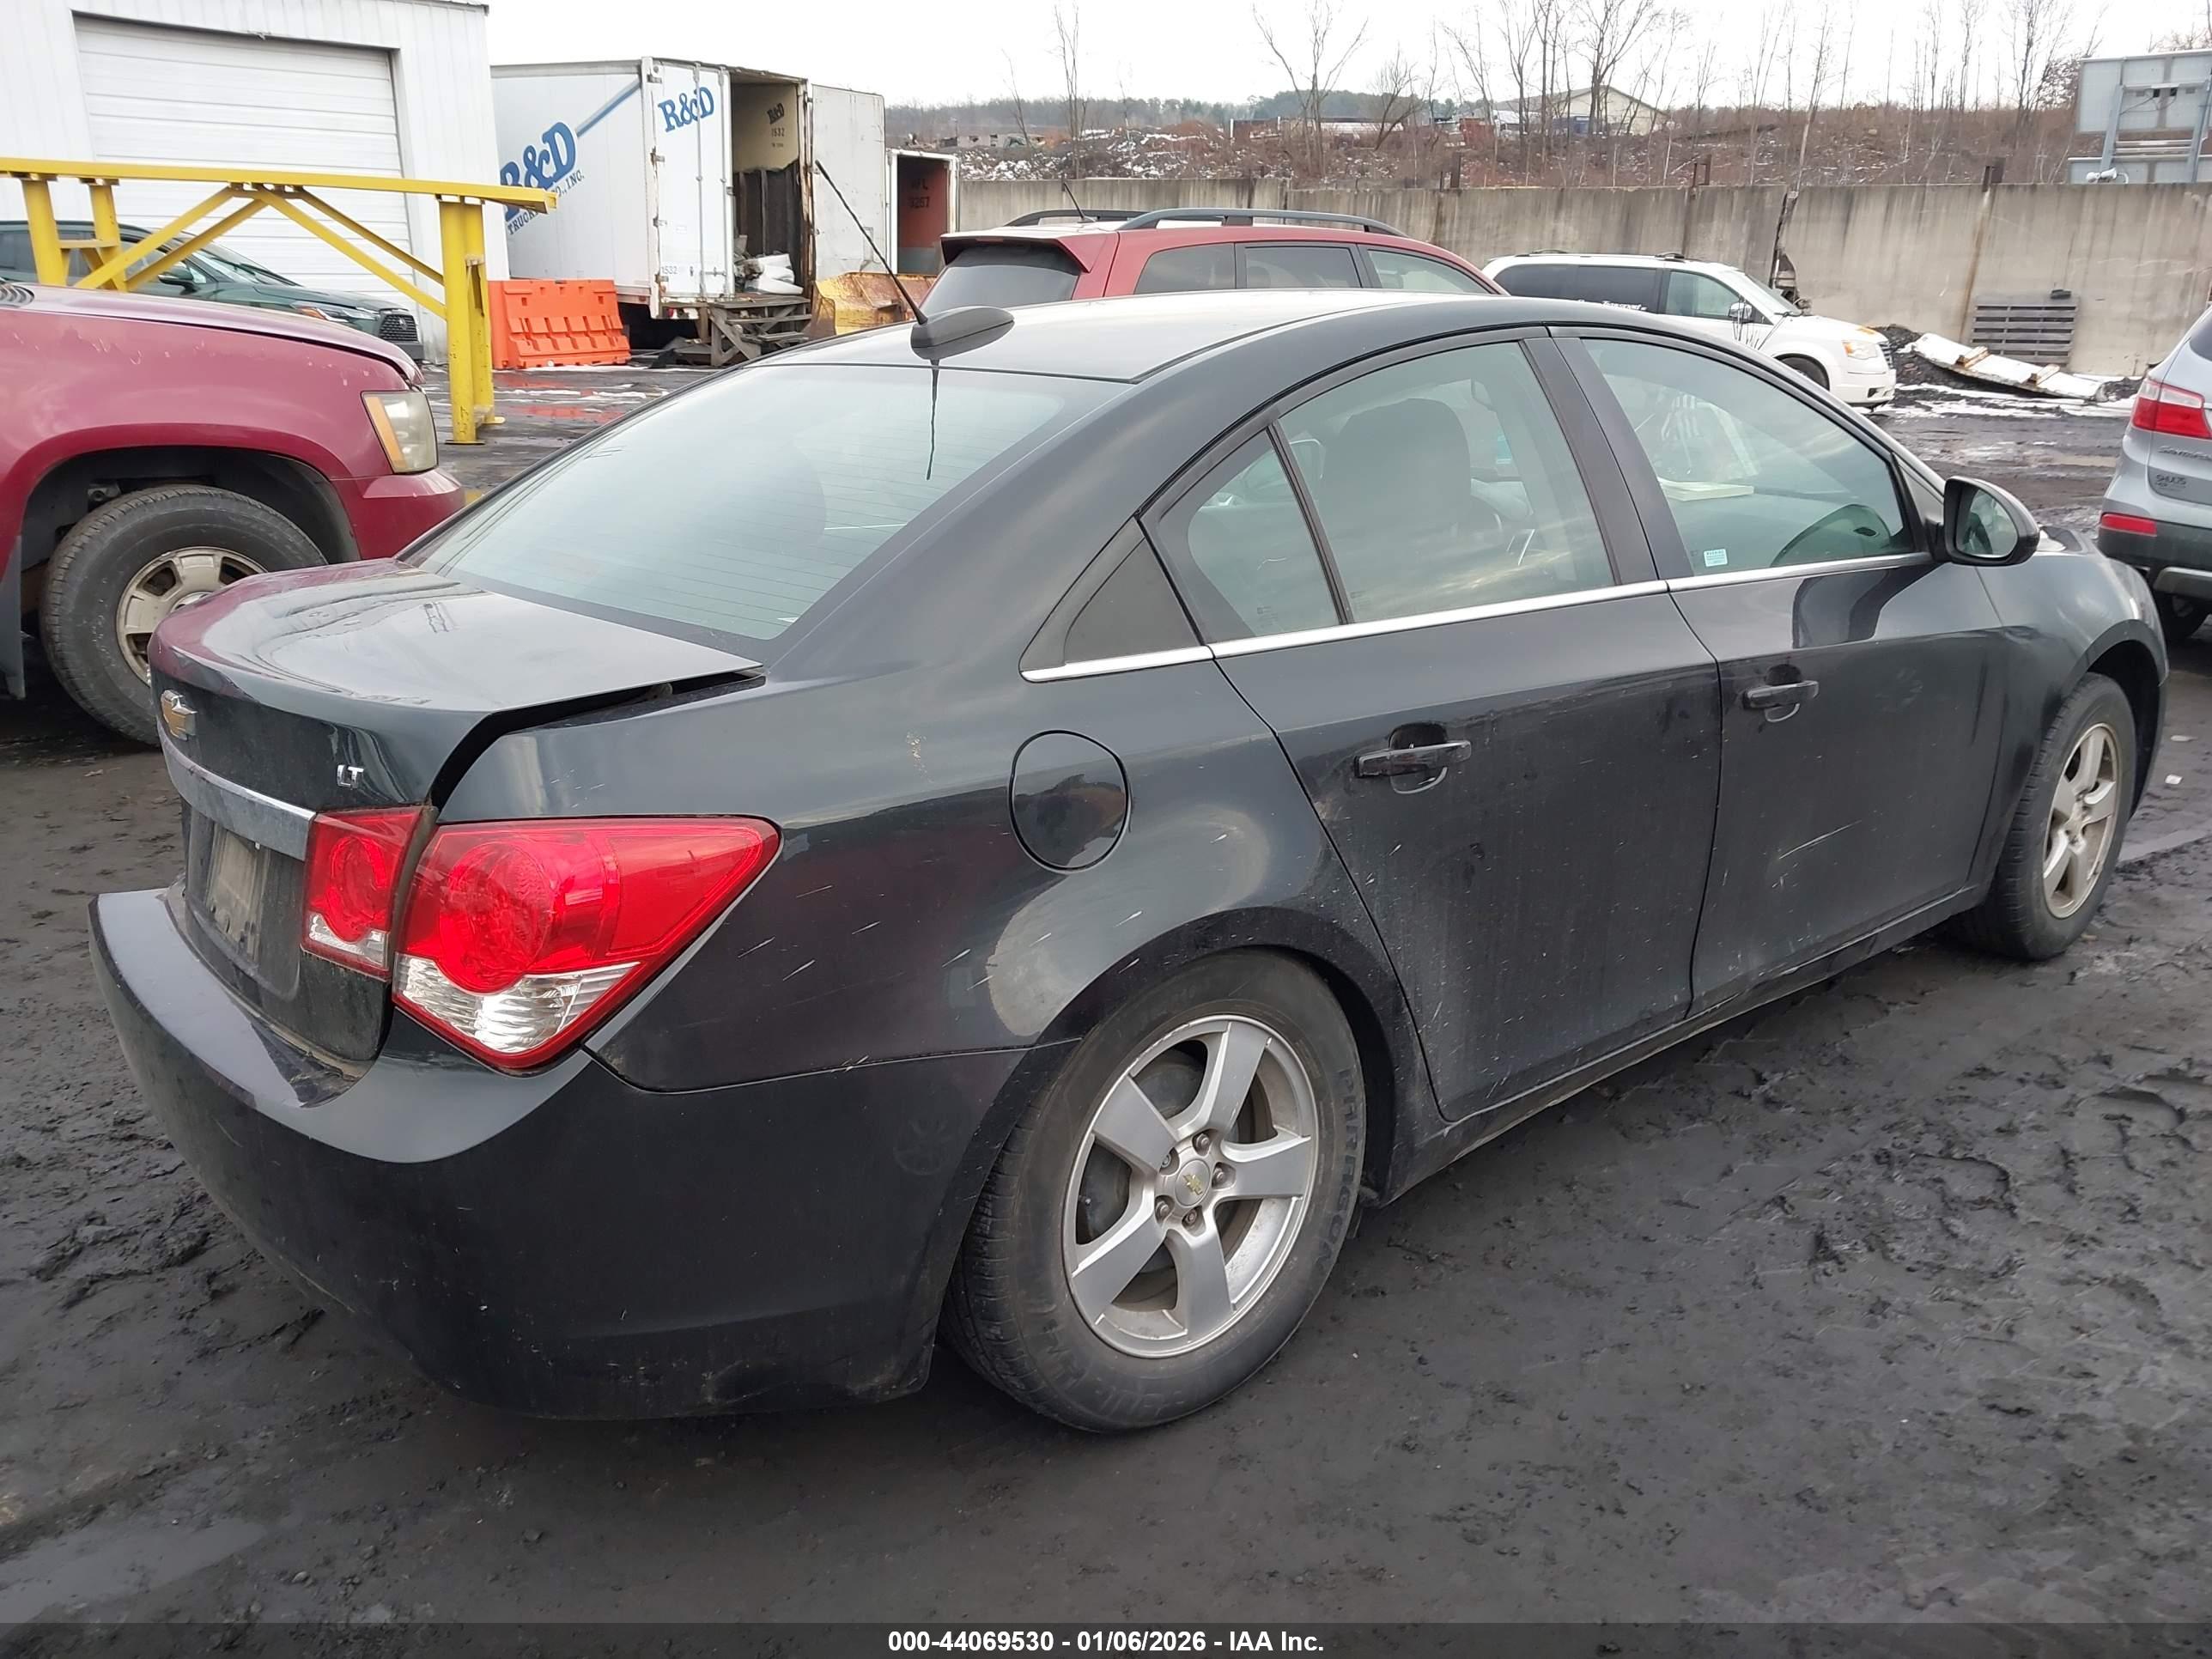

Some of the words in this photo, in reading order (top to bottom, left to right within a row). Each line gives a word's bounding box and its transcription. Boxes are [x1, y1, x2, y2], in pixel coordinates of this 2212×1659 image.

[658, 87, 714, 132] R&D
[501, 122, 575, 222] R&D
[661, 265, 678, 275] 1532
[337, 764, 364, 788] LT
